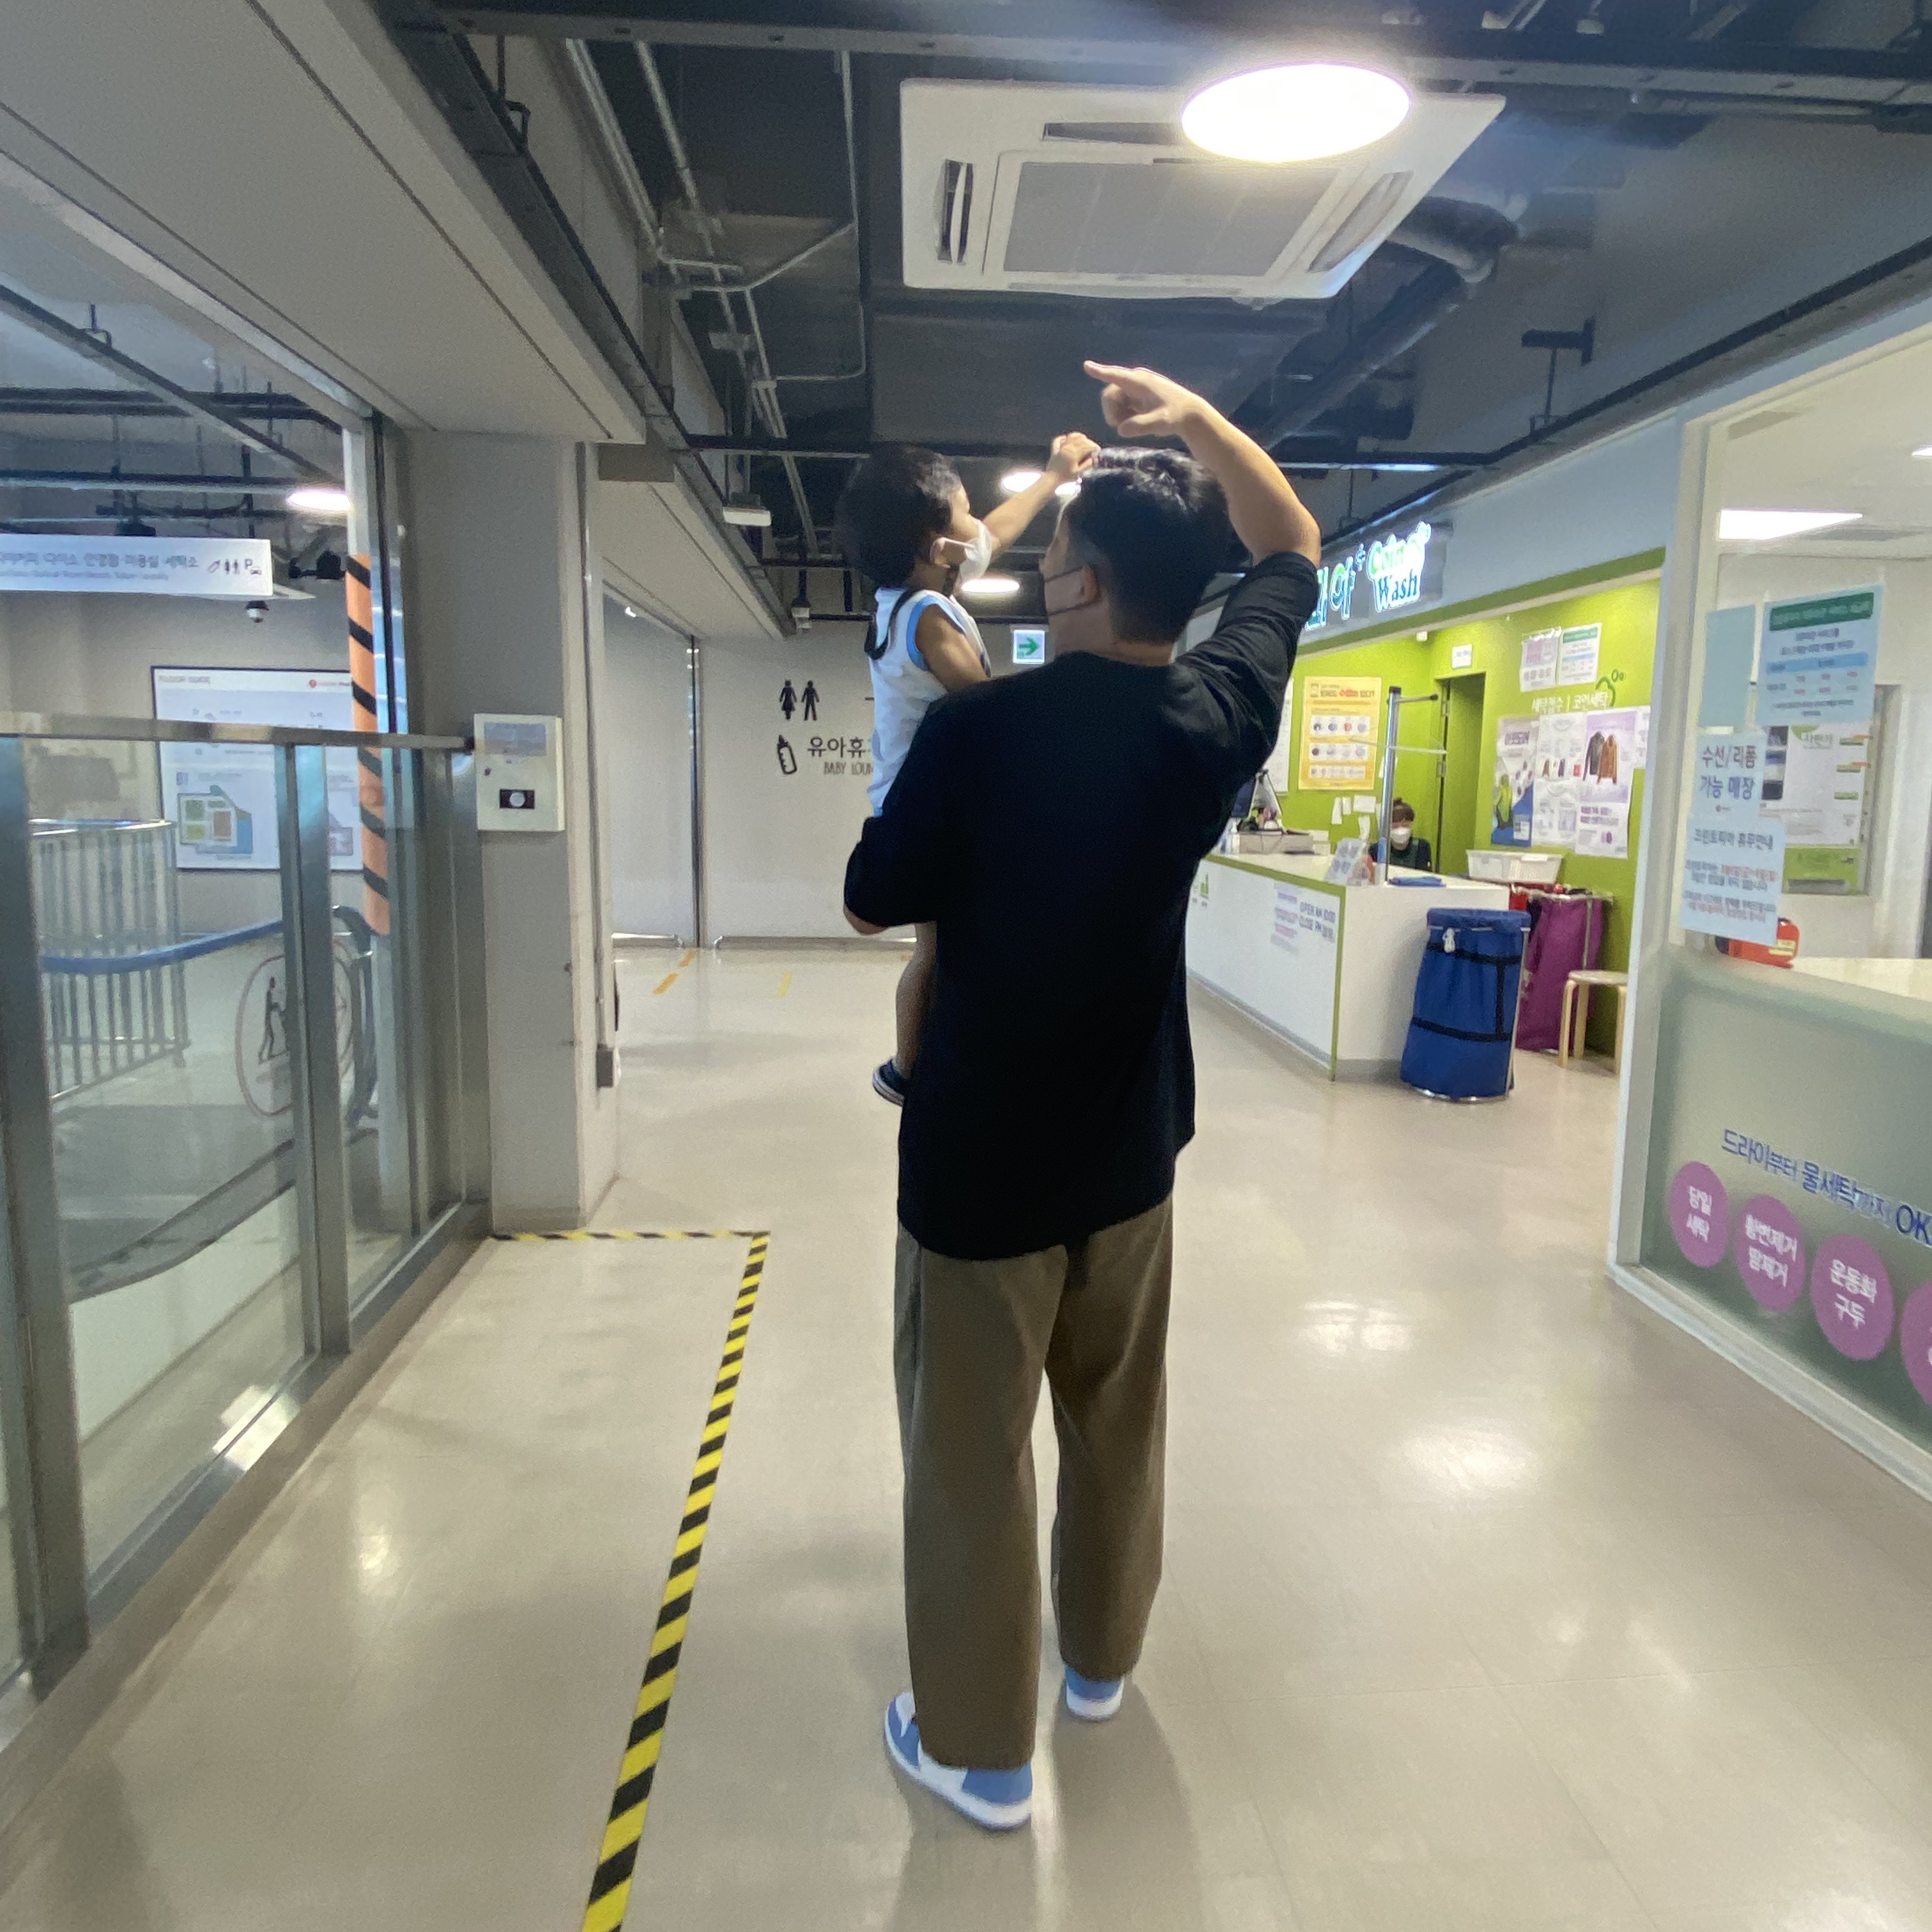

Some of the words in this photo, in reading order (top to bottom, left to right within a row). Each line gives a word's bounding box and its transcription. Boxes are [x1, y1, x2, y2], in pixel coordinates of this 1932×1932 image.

[1376, 568, 1418, 611] Wash
[824, 762, 847, 775] BABY
[1702, 744, 1757, 769] 수선/리폼
[1699, 774, 1724, 799] 가능
[1728, 776, 1755, 800] 매장
[1686, 1213, 1710, 1243] 세탁
[1830, 1259, 1877, 1303] 운동화
[1834, 1292, 1866, 1330] 구두
